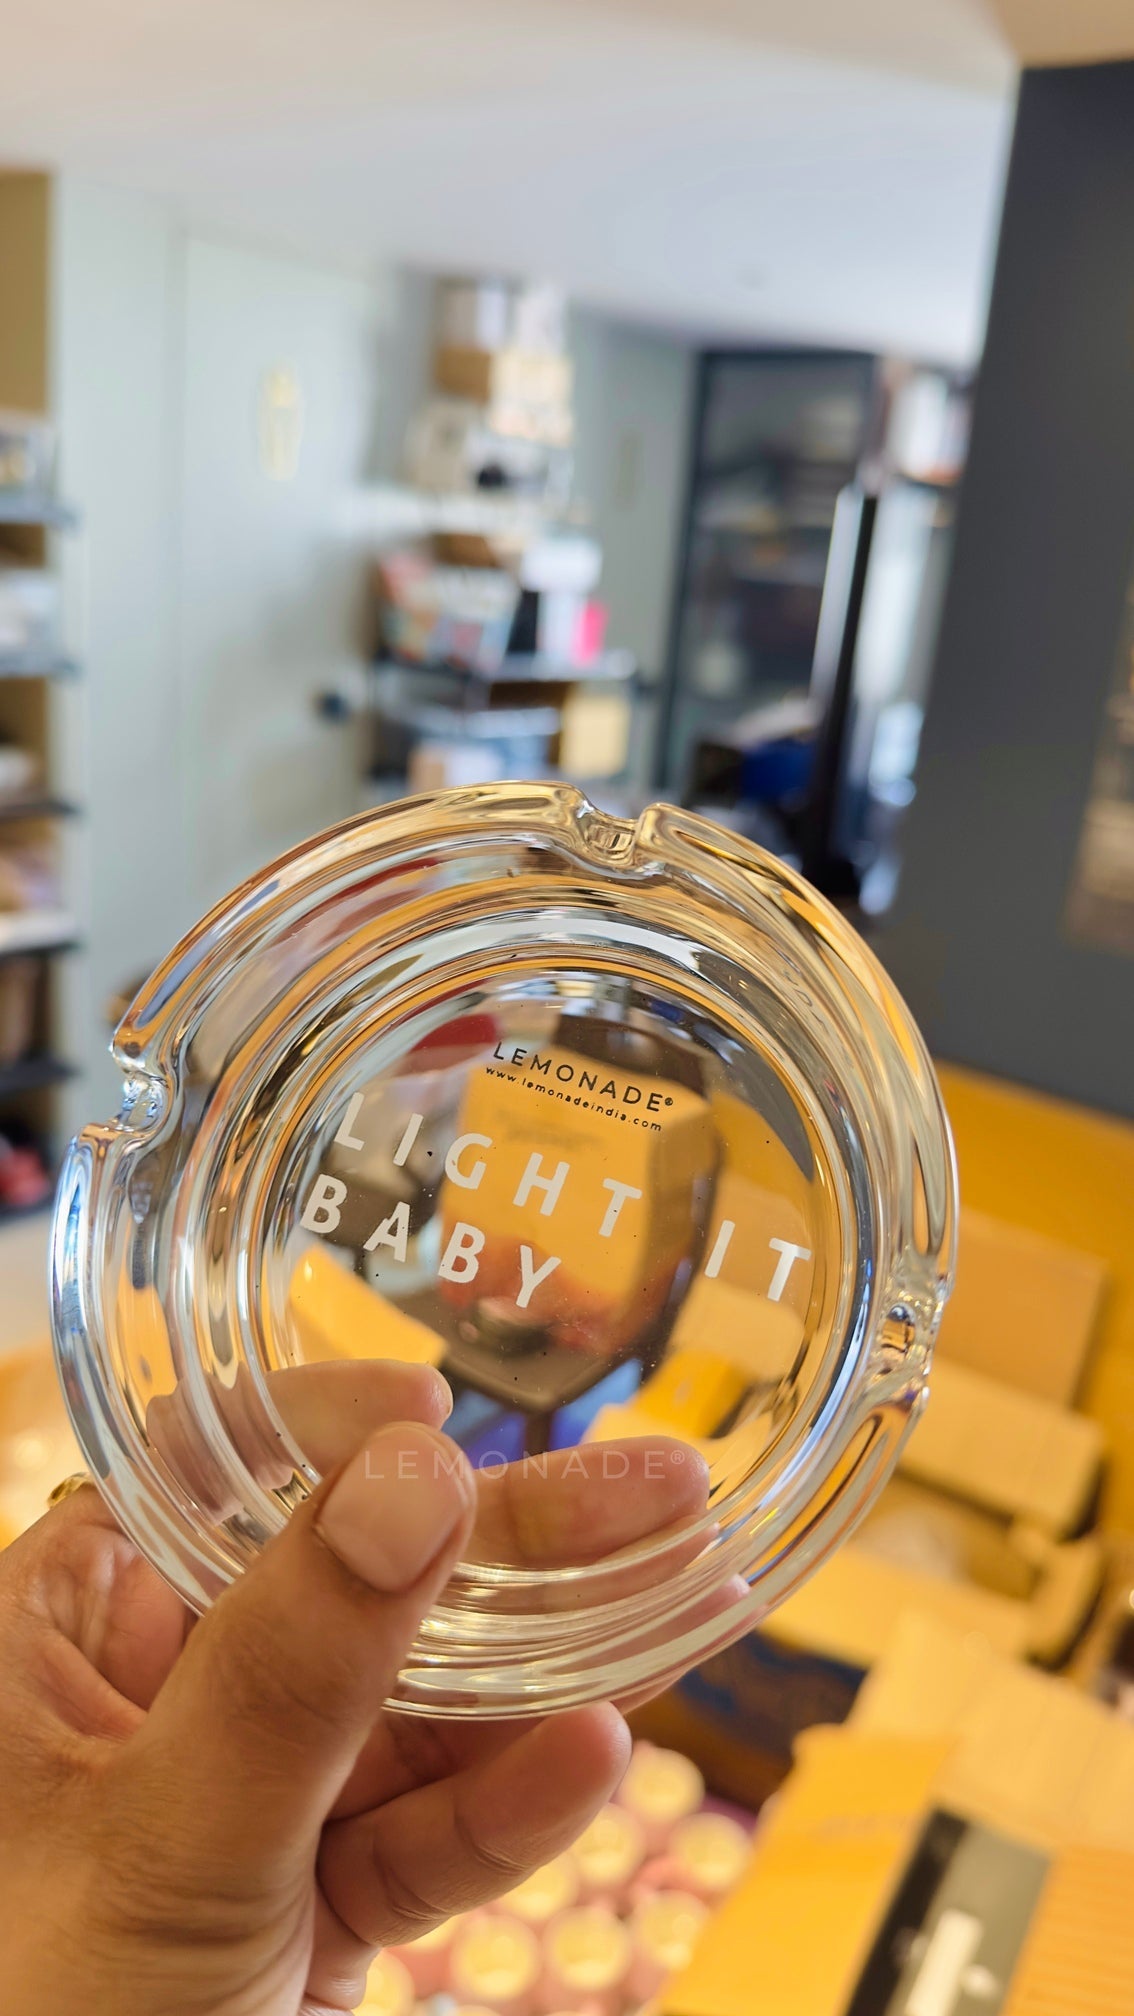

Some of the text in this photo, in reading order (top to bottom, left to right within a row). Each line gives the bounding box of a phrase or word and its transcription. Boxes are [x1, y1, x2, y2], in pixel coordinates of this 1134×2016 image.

[485, 1066, 662, 1131] www.lemonadeindia.com
[299, 1174, 562, 1309] BABY
[333, 1092, 811, 1302] LIGHT IT
